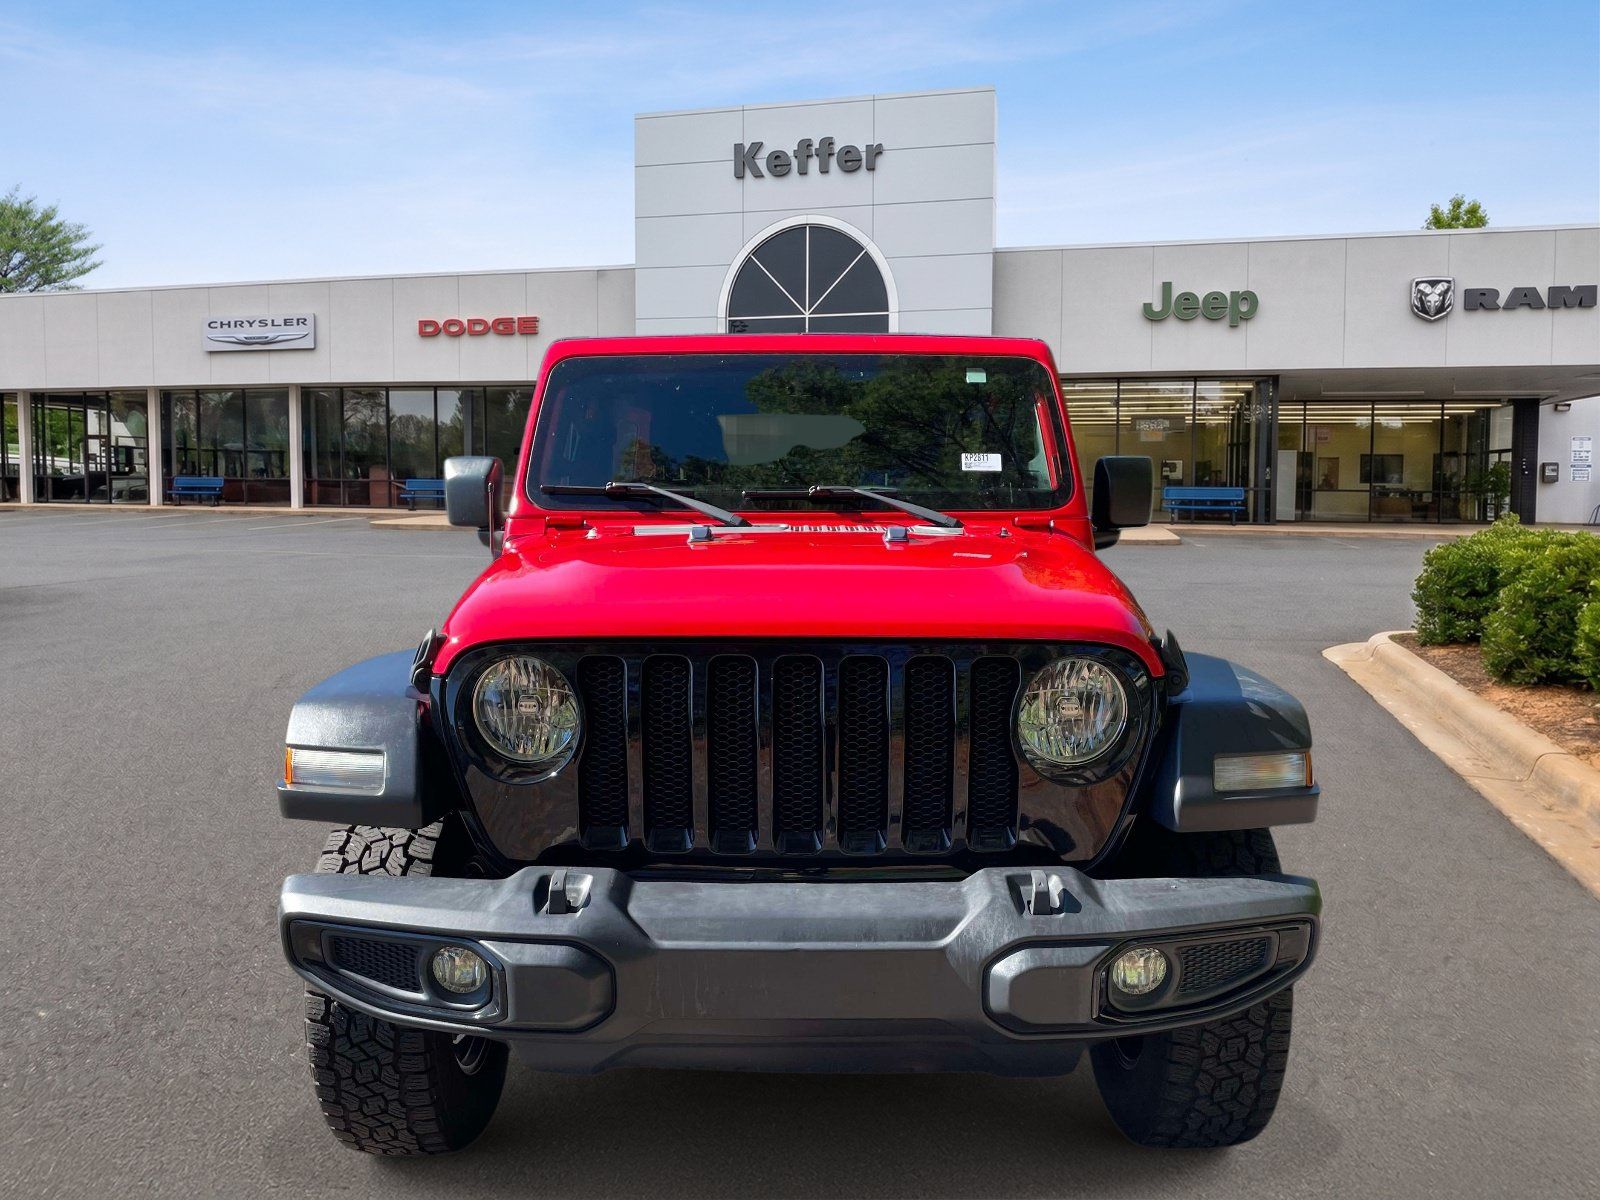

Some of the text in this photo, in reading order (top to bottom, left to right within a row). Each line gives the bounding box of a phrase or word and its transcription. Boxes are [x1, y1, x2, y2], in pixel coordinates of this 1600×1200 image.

[733, 136, 884, 179] Keffer
[1142, 281, 1259, 328] Jeep
[1463, 284, 1598, 311] RAM
[207, 317, 308, 330] CHRYSLER
[418, 316, 540, 337] DODGE
